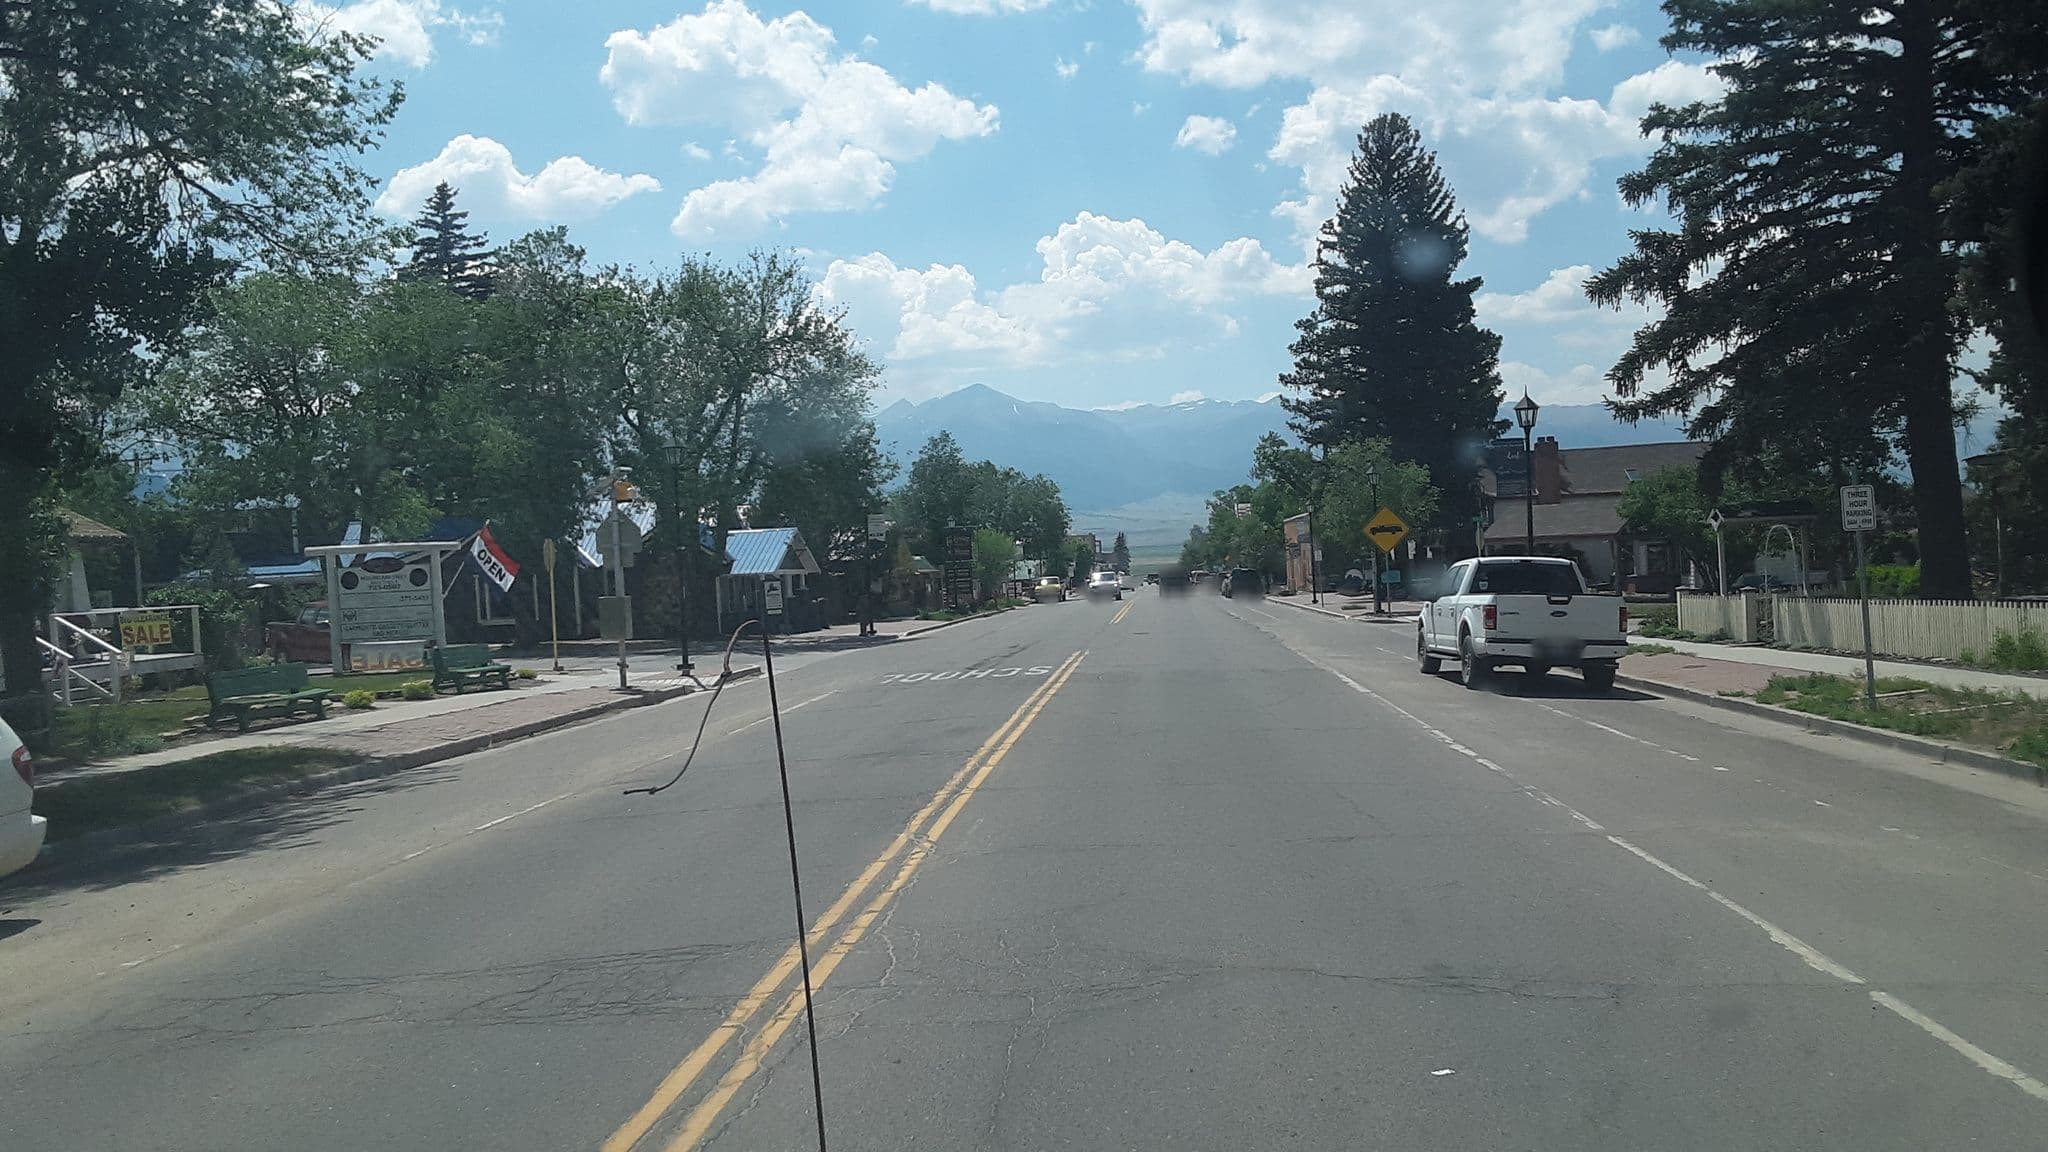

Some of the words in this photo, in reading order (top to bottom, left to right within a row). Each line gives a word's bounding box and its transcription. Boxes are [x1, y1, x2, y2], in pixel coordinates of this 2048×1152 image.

[1846, 509, 1873, 517] PARKING
[1848, 500, 1868, 508] HOUR
[477, 549, 506, 582] OPEN
[122, 624, 171, 645] SALE
[880, 665, 1053, 684] SCHOOL
